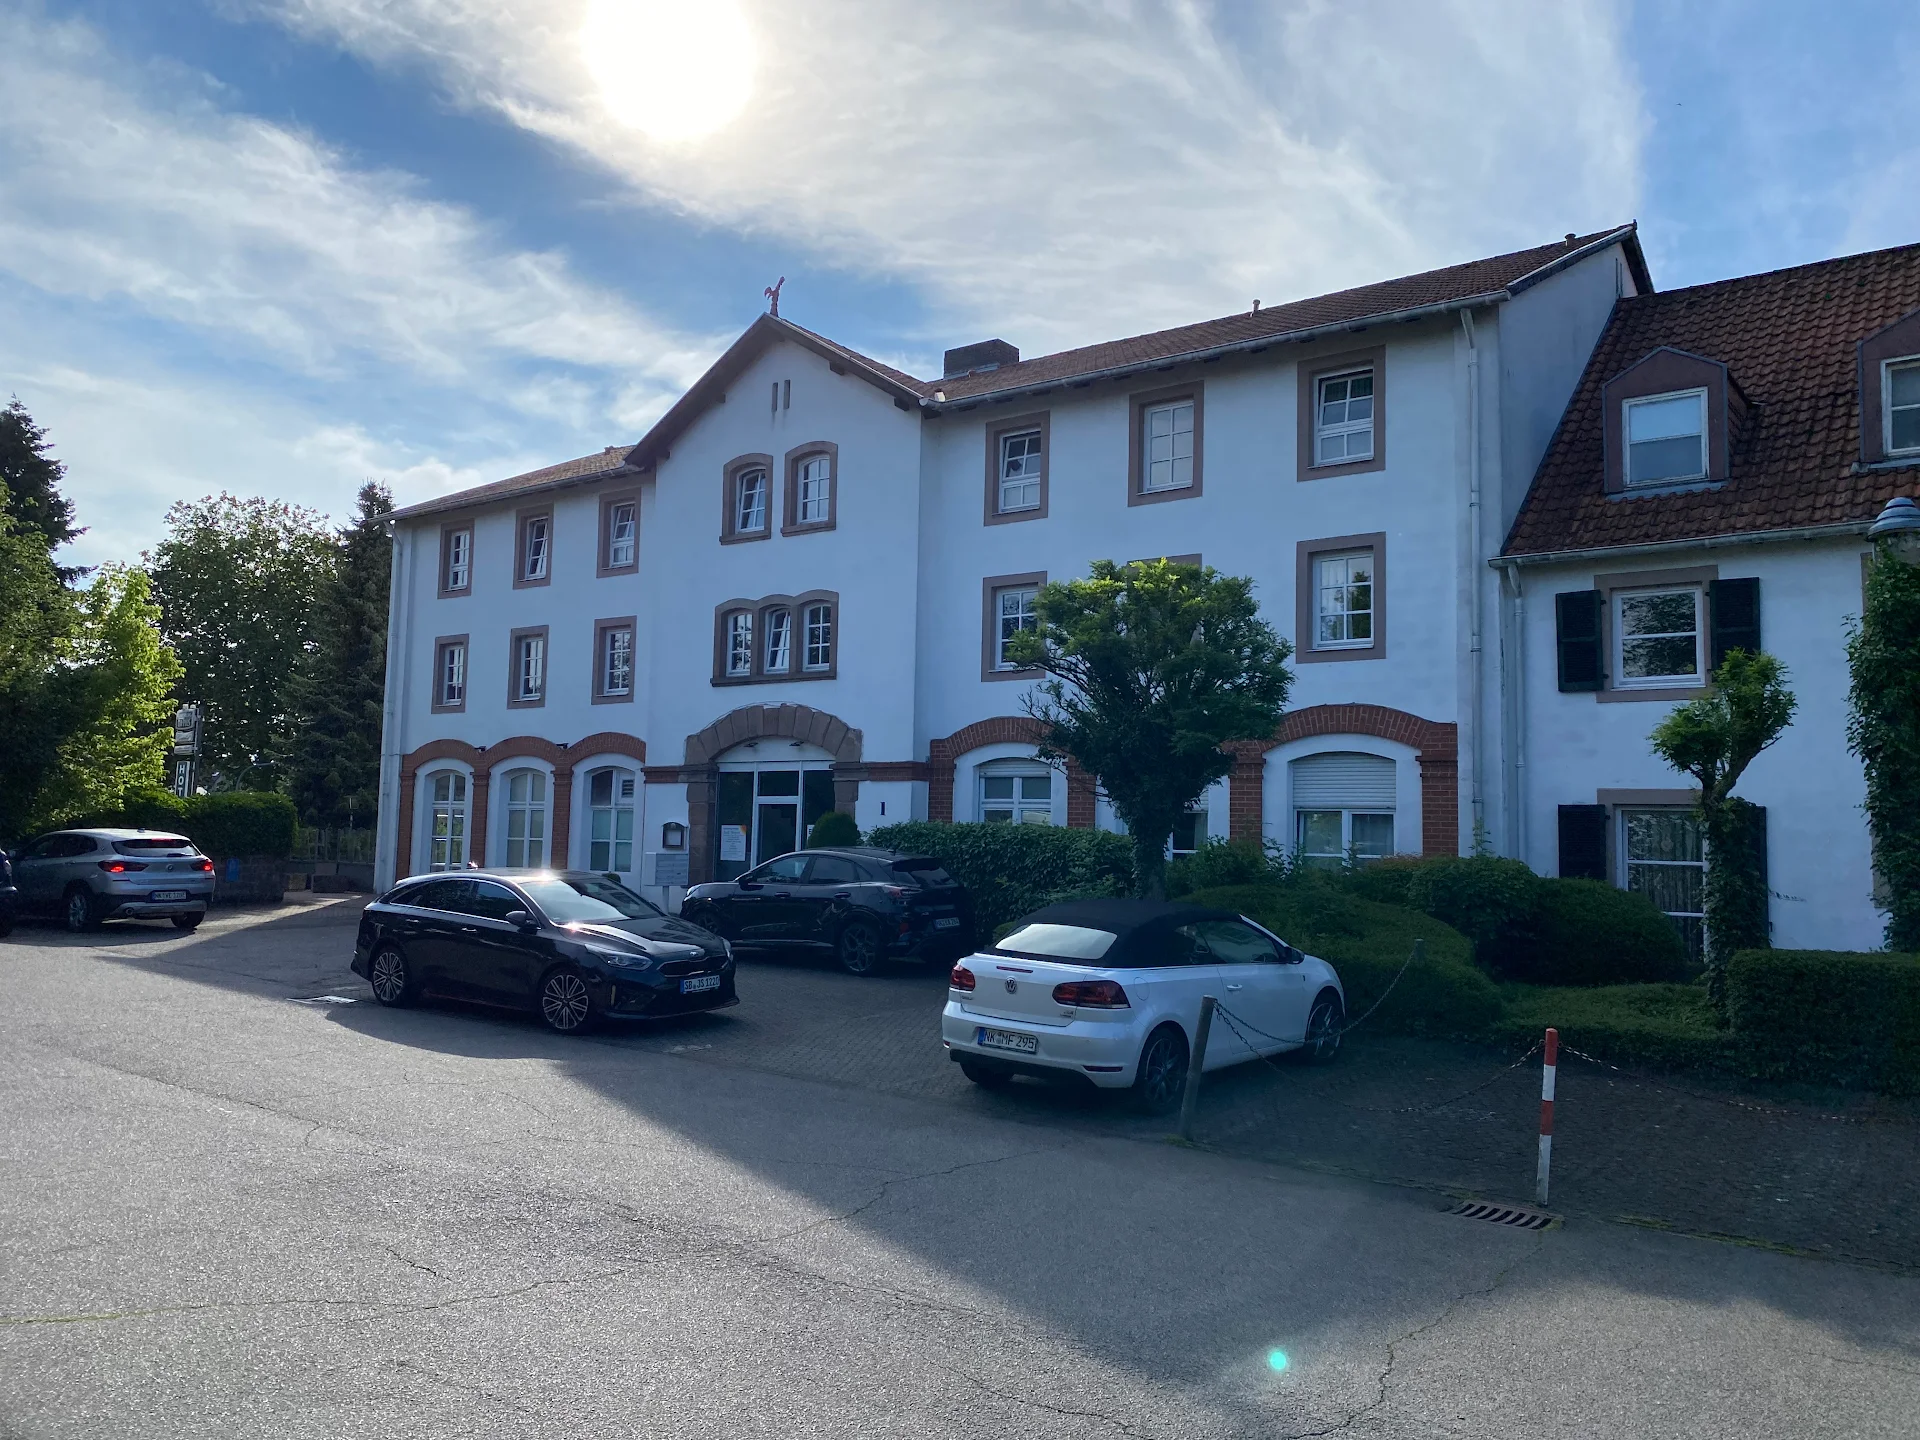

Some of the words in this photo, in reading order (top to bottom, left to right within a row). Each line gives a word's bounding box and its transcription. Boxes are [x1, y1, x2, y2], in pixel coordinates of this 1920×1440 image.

[684, 980, 693, 990] SB
[697, 979, 705, 989] JS
[984, 1030, 996, 1043] NK
[1001, 1032, 1015, 1046] MF
[1016, 1035, 1035, 1049] 295
